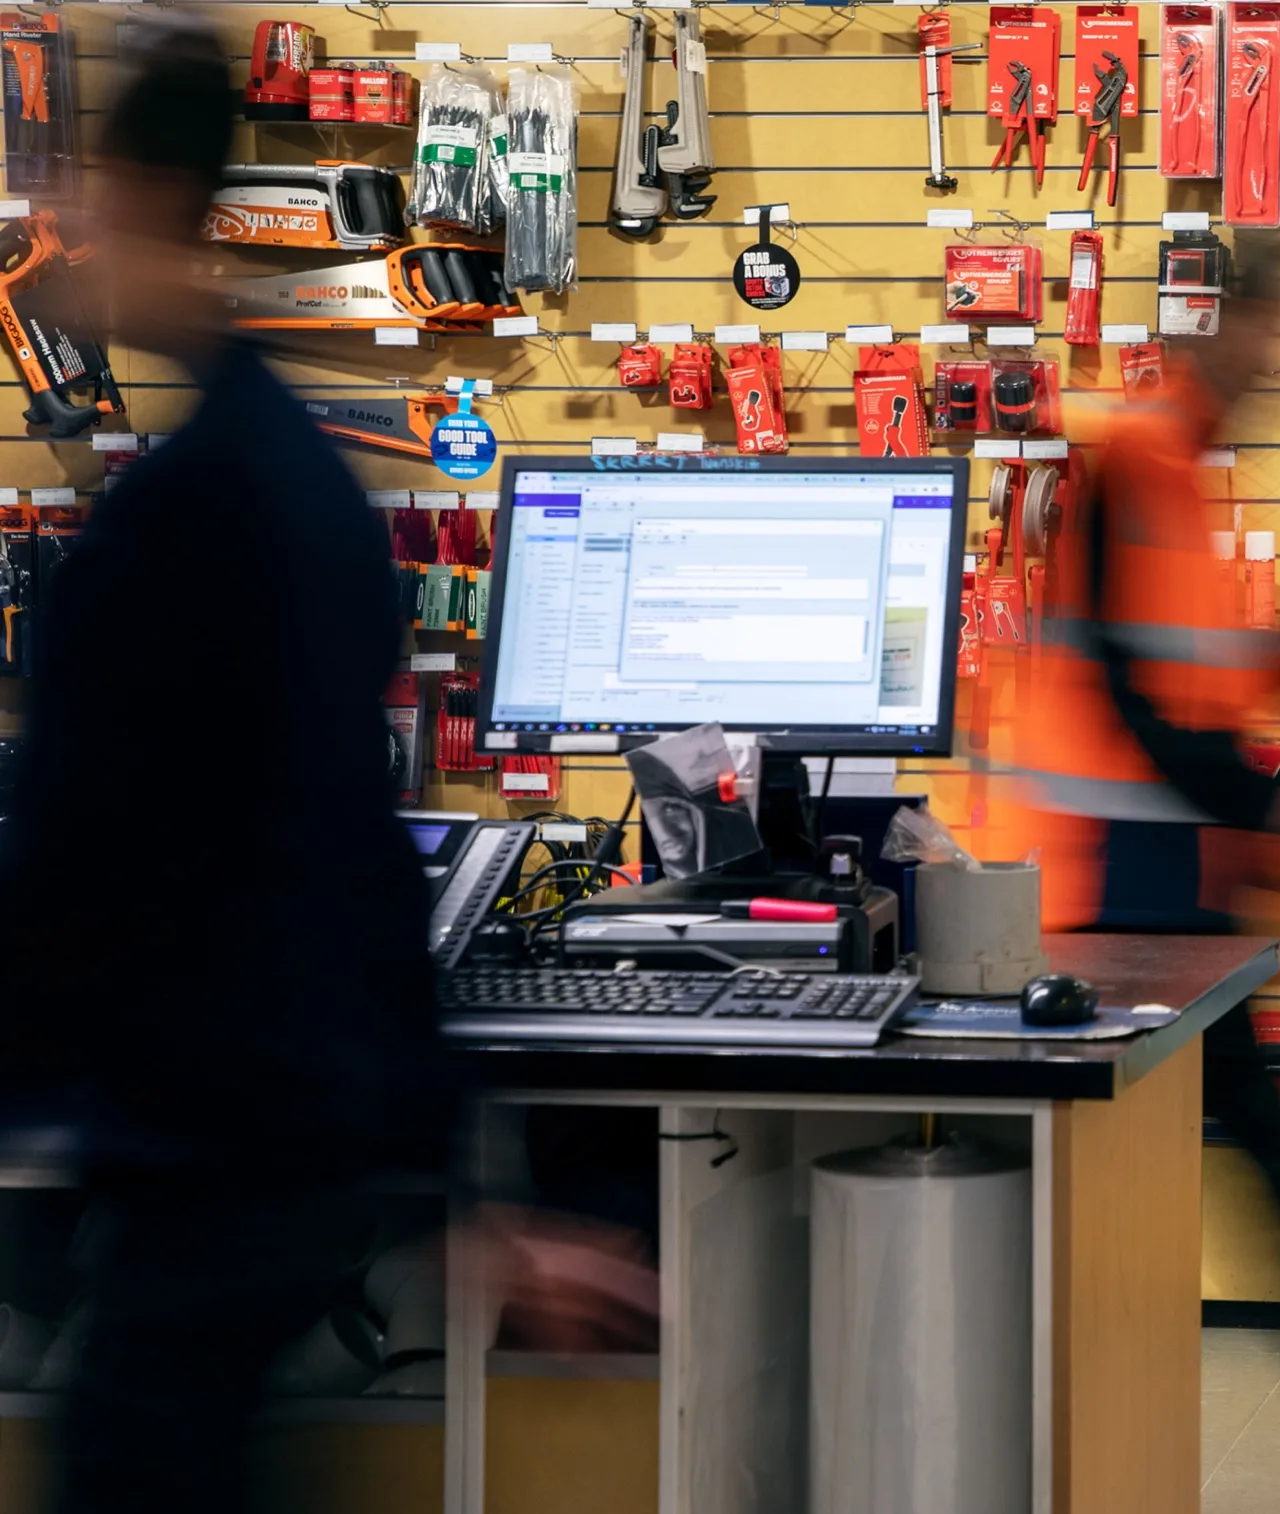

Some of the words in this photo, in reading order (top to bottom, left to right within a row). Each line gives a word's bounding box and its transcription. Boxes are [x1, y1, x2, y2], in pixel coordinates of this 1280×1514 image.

[292, 30, 302, 71] EVEREADY
[360, 77, 389, 85] MALLORY
[287, 198, 319, 206] BAHCO
[743, 252, 770, 265] GRAB
[744, 265, 753, 278] A
[752, 264, 786, 278] BONUS
[295, 285, 348, 299] BAHCO
[0, 306, 24, 348] BIGDOG
[29, 318, 52, 356] Hacksaw
[47, 354, 65, 385] 300mm
[347, 408, 394, 427] BAHCO
[438, 430, 464, 443] GOOD
[464, 430, 488, 443] TOOL
[450, 443, 477, 456] GUIDE
